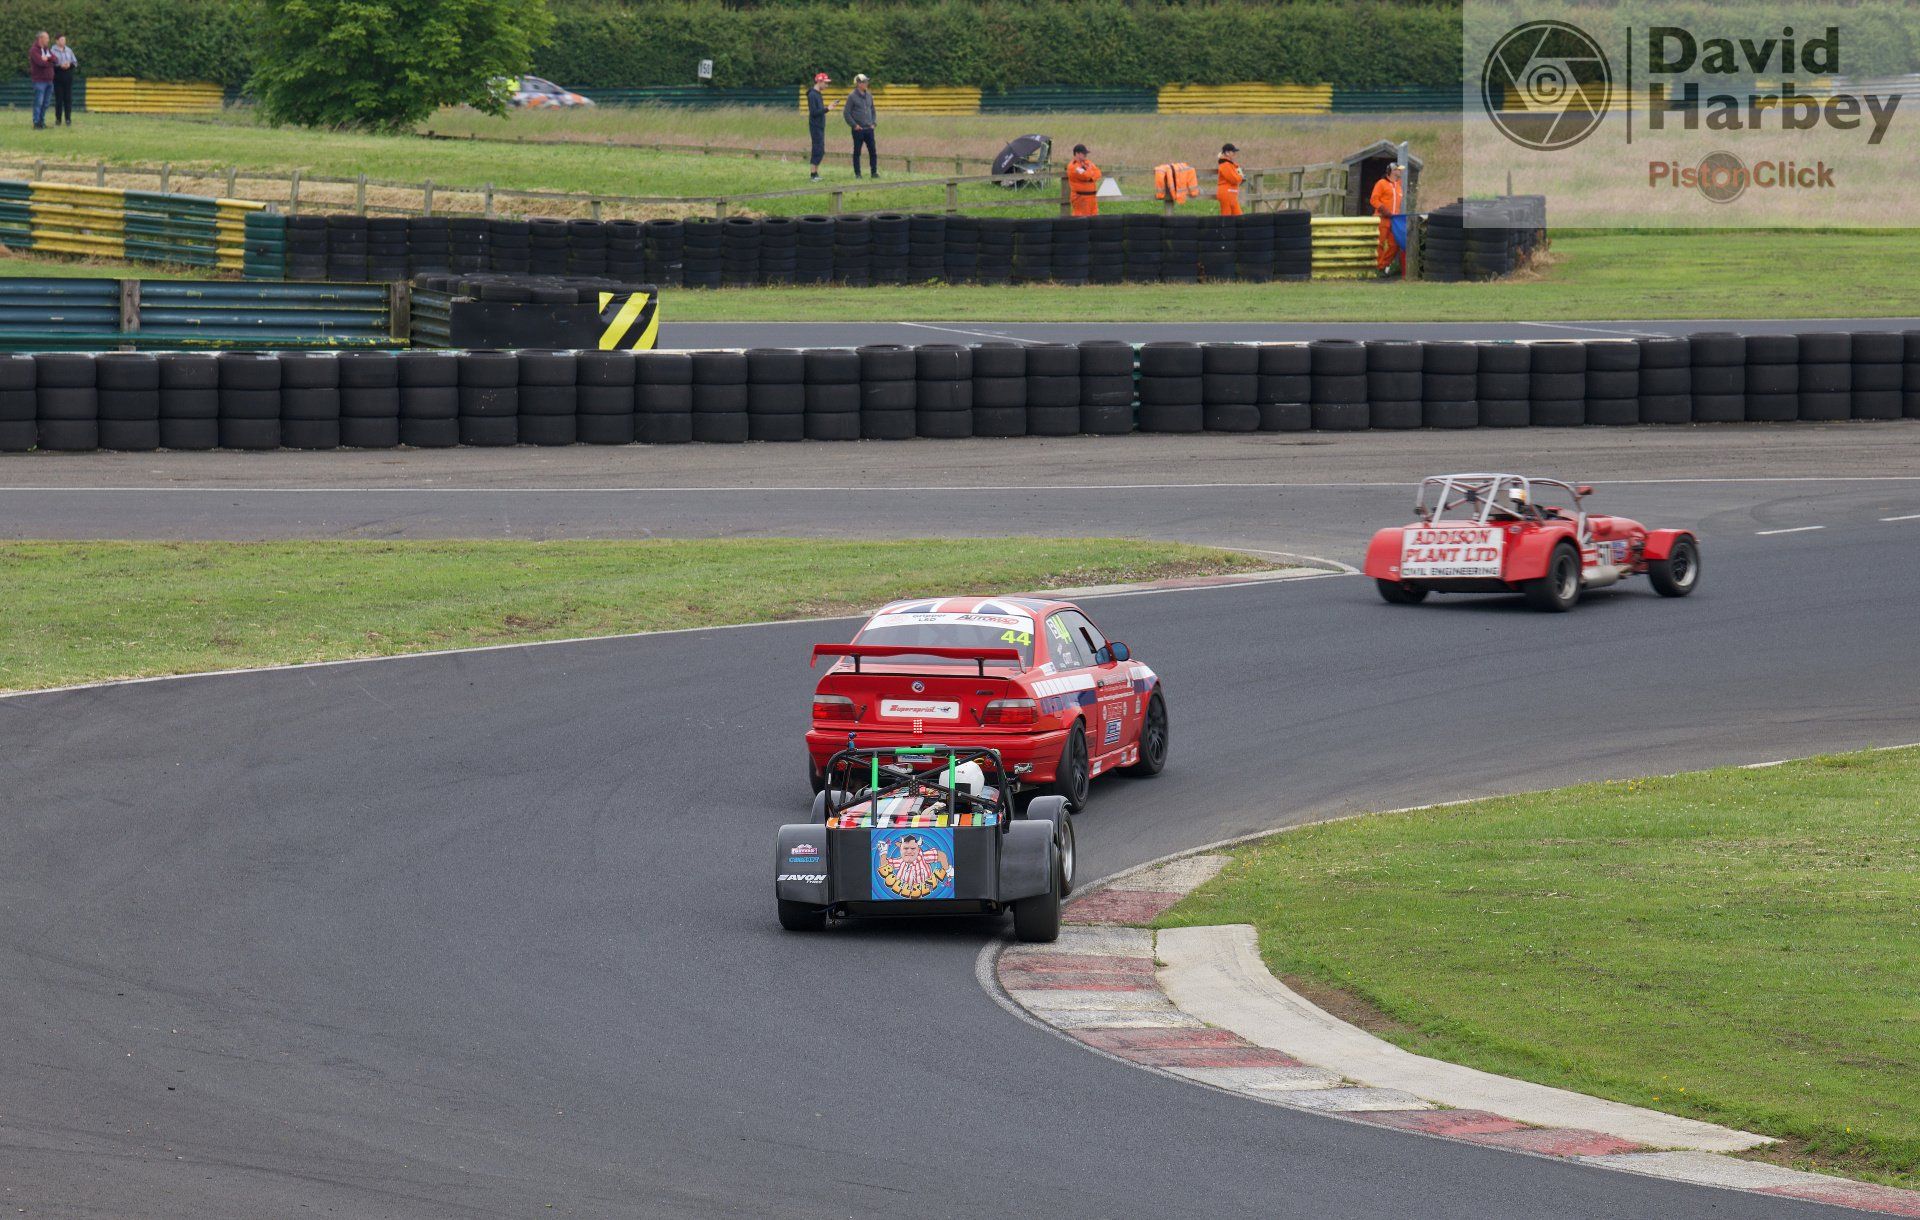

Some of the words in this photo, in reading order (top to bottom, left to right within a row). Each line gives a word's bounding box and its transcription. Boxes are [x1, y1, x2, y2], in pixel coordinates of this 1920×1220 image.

[1411, 530, 1491, 545] ADDISON
[1402, 548, 1460, 562] PLANT
[1464, 547, 1498, 562] LTD
[1401, 568, 1427, 576] CIVIL
[1431, 567, 1498, 576] ENGINEERING
[1000, 630, 1032, 646] 44
[889, 705, 936, 713] Supersprint
[877, 864, 947, 899] BULLSEYE
